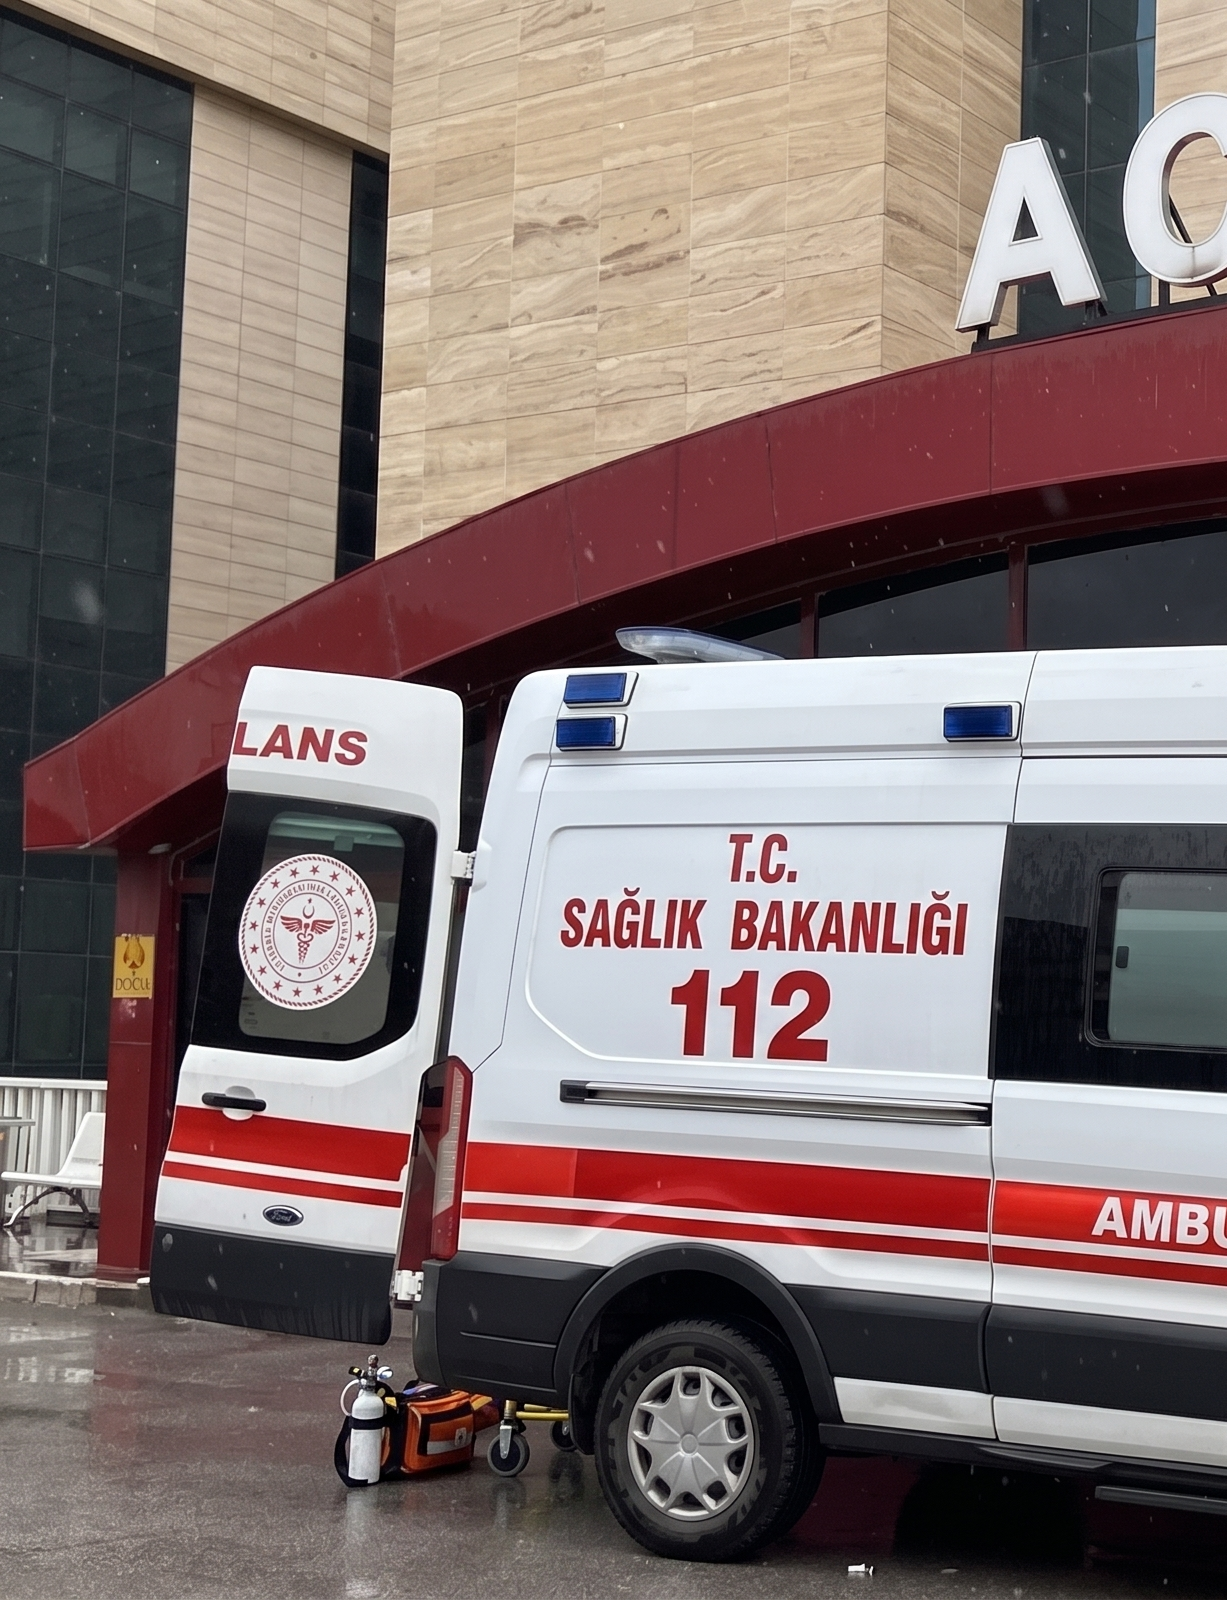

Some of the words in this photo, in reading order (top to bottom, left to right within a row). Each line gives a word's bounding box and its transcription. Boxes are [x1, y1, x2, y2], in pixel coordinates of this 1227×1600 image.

[232, 721, 367, 766] LANS
[729, 833, 798, 883] T.C.
[560, 887, 707, 949] SAĞLIK
[730, 890, 969, 955] BAKANLIĞI
[671, 969, 831, 1062] 112
